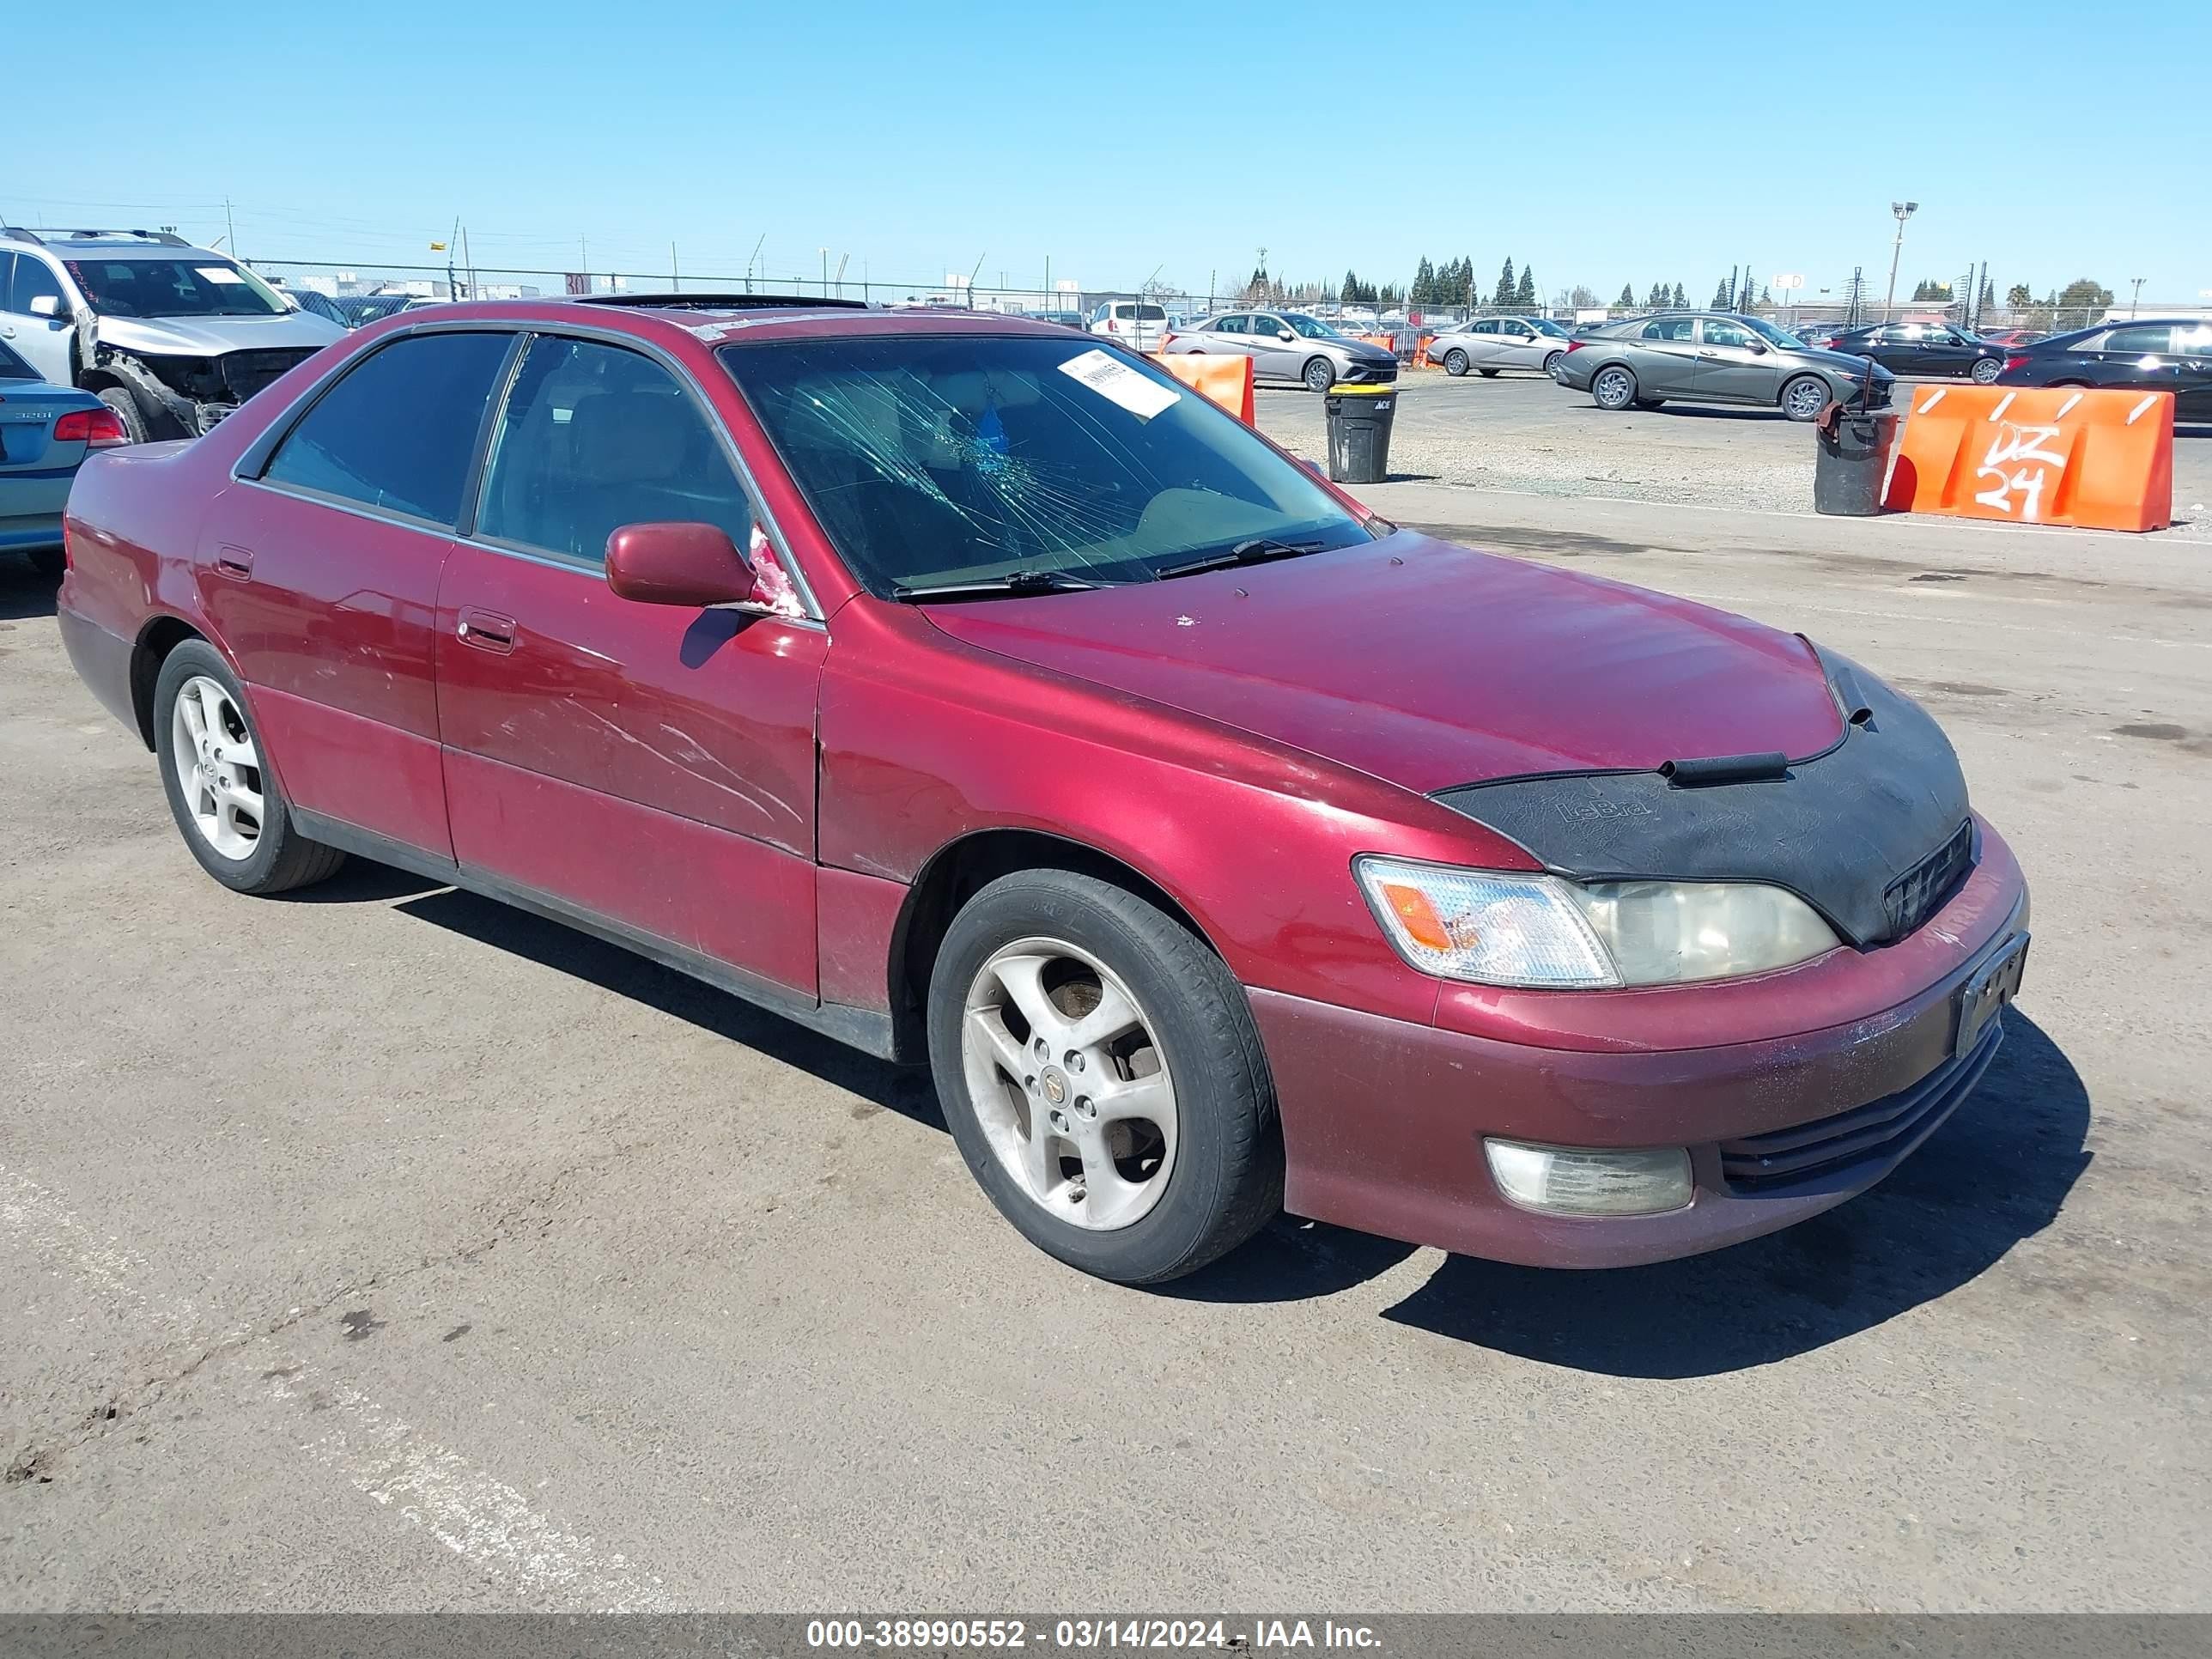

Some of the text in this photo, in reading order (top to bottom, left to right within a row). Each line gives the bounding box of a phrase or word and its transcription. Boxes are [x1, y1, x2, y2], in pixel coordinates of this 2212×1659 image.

[1374, 400, 1391, 410] ACE
[1975, 467, 2045, 522] 24
[1555, 799, 1652, 823] LeBra
